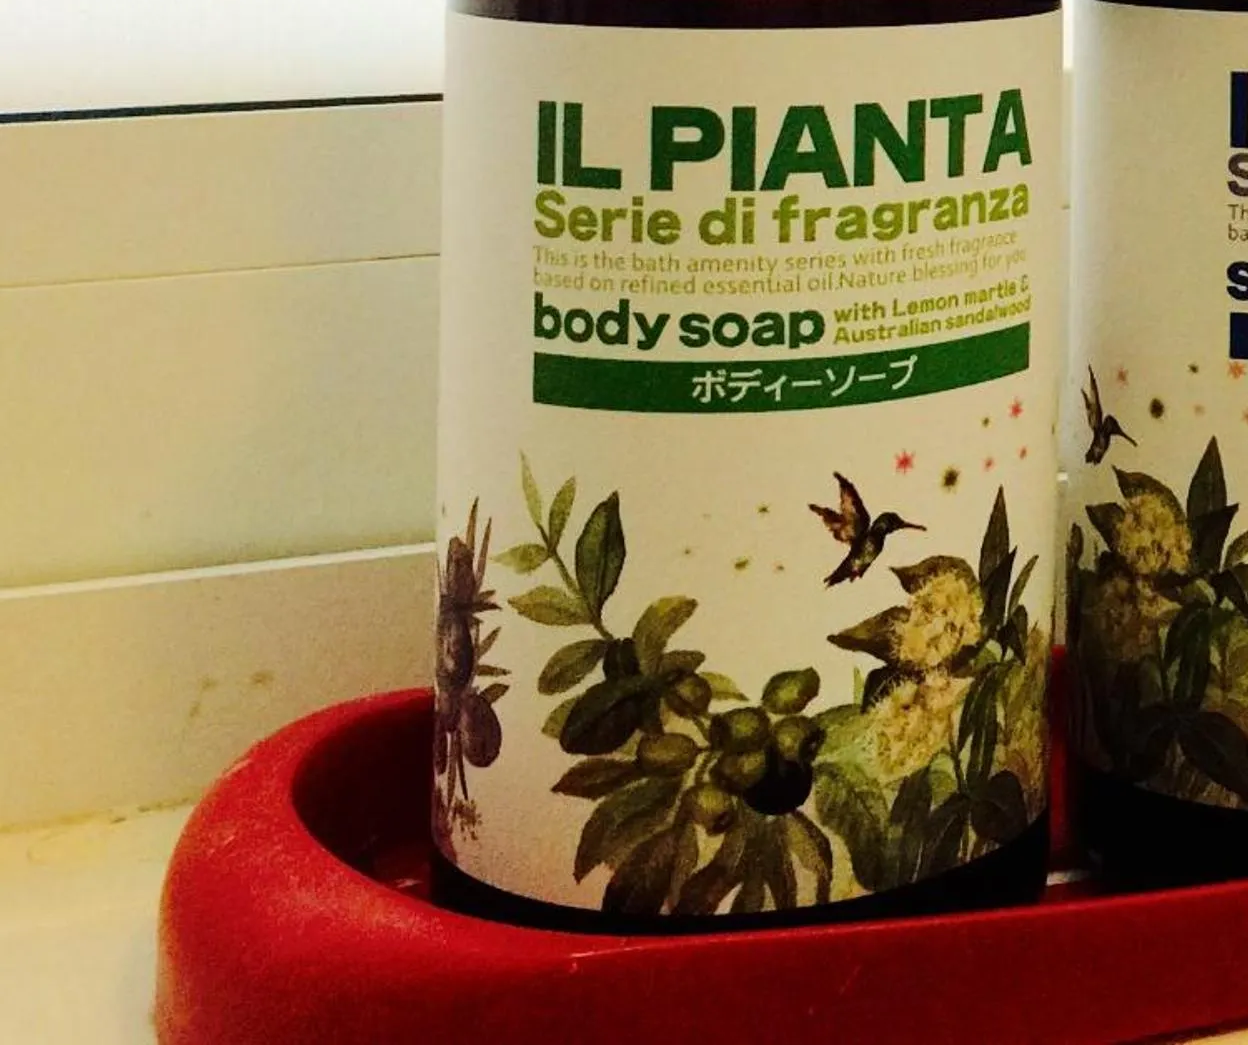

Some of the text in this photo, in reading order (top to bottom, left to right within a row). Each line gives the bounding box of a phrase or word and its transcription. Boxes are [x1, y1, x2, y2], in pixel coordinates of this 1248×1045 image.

[537, 88, 1032, 191] IL PIANTA
[534, 183, 1029, 245] Serie di fragranza
[533, 245, 567, 265] This
[574, 252, 588, 268] is
[593, 251, 625, 270] the
[632, 254, 679, 272] bath
[687, 255, 777, 276] amenity
[785, 253, 847, 272] series
[852, 246, 896, 265] with
[902, 239, 945, 260] fresh
[533, 268, 584, 290] based
[589, 275, 615, 291] on
[620, 275, 696, 295] refined
[703, 274, 801, 295] essential
[913, 256, 978, 282] blessing
[982, 253, 1001, 271] for
[534, 291, 825, 350] body soap
[832, 295, 1032, 345] Australian sandalwood
[833, 299, 885, 323] with
[893, 293, 959, 317] Lemon
[691, 355, 918, 404] ボディーソープ
